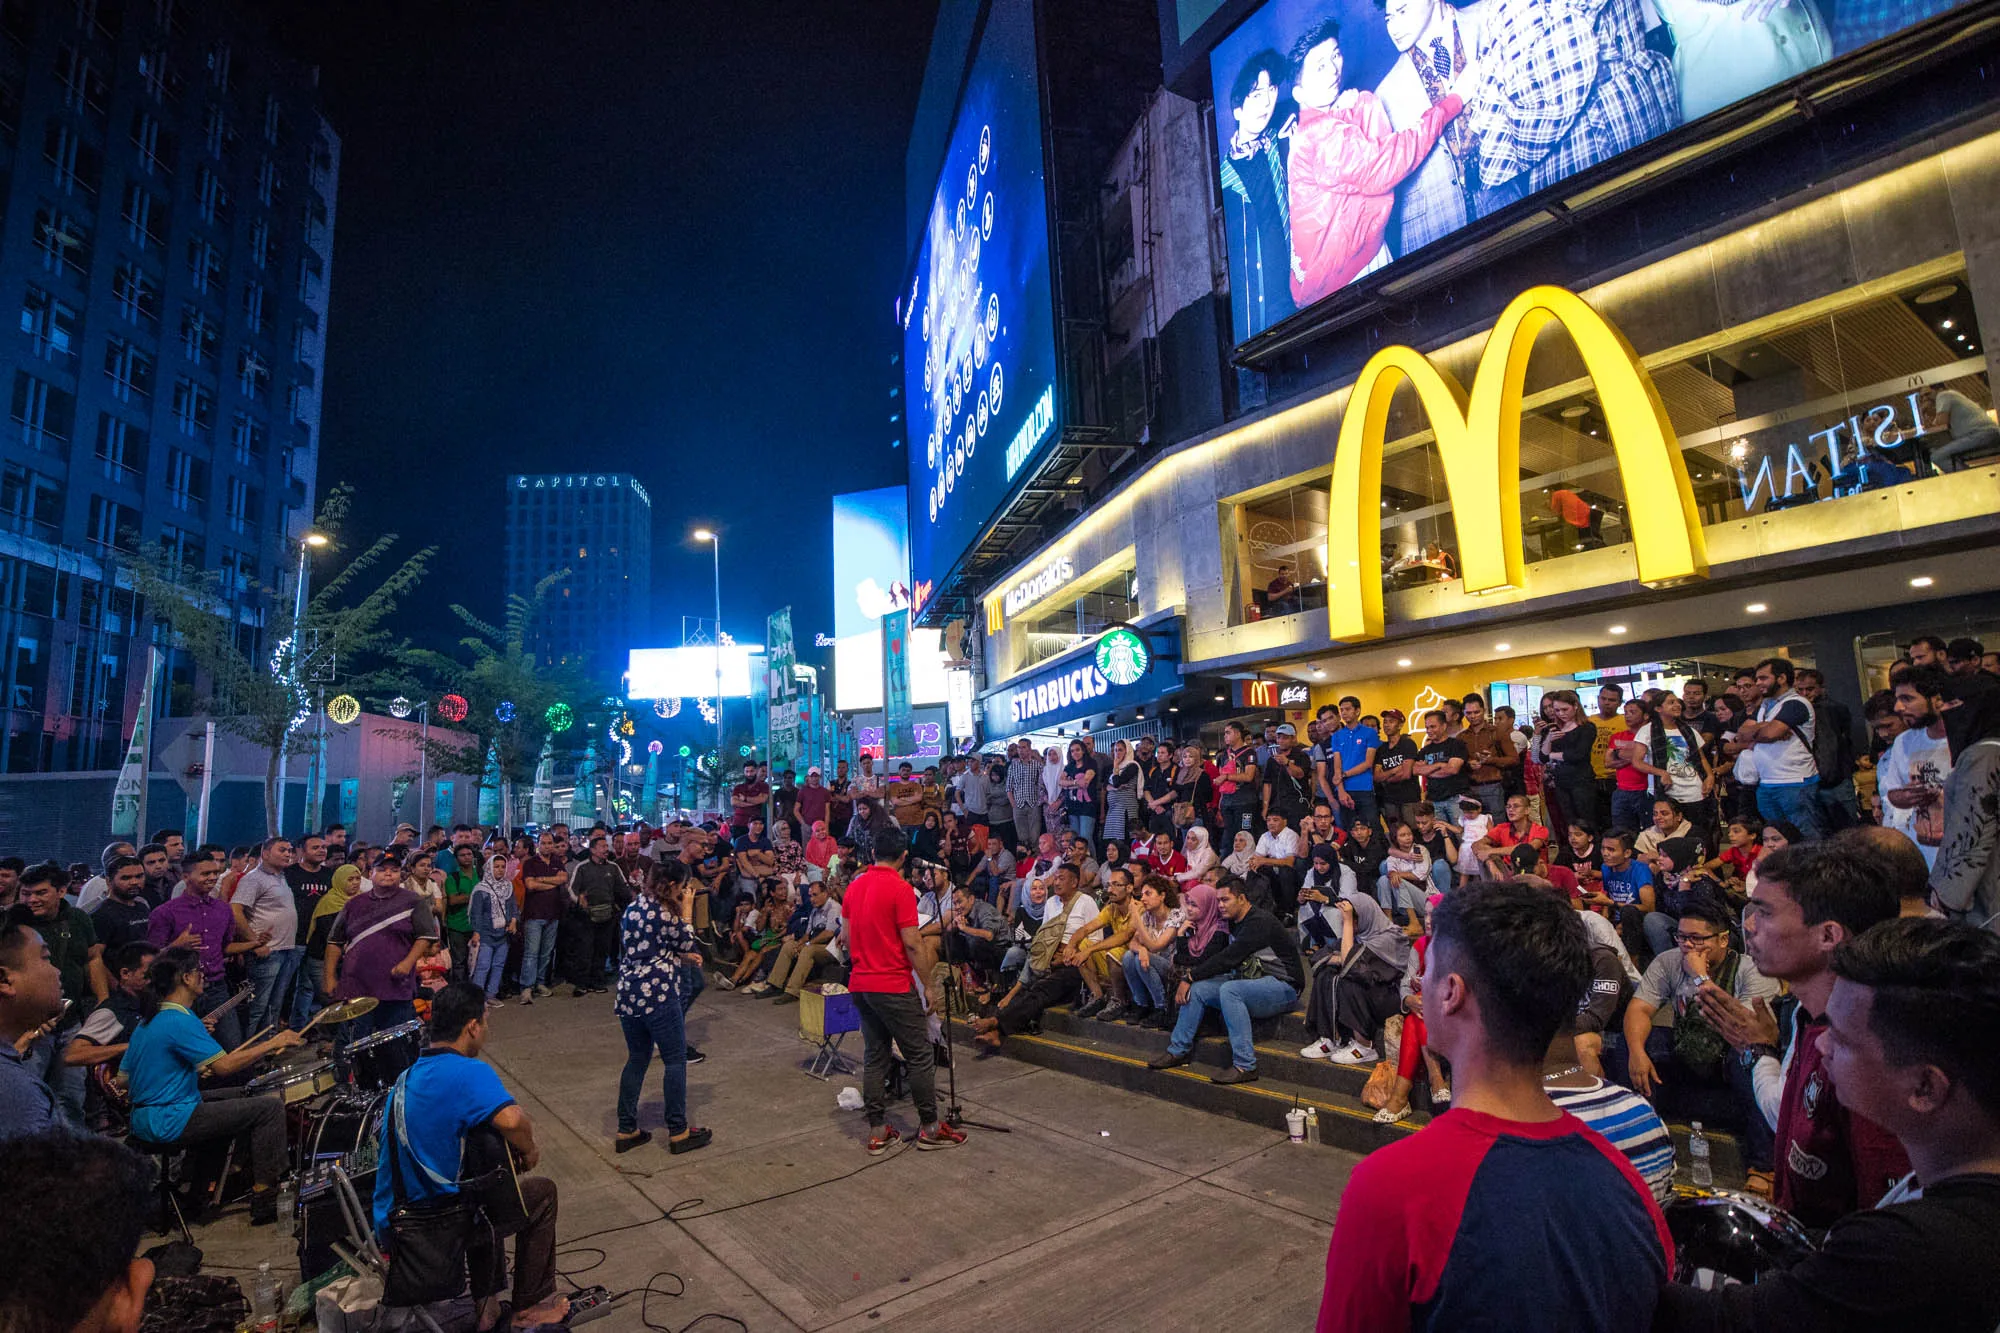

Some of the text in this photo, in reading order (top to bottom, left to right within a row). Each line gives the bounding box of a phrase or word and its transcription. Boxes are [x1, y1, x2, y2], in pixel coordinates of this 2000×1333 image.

[516, 475, 621, 488] CAPITOL
[1004, 555, 1075, 618] McDonald's
[1010, 664, 1108, 723] STARBUCKS
[858, 721, 941, 747] SPTS
